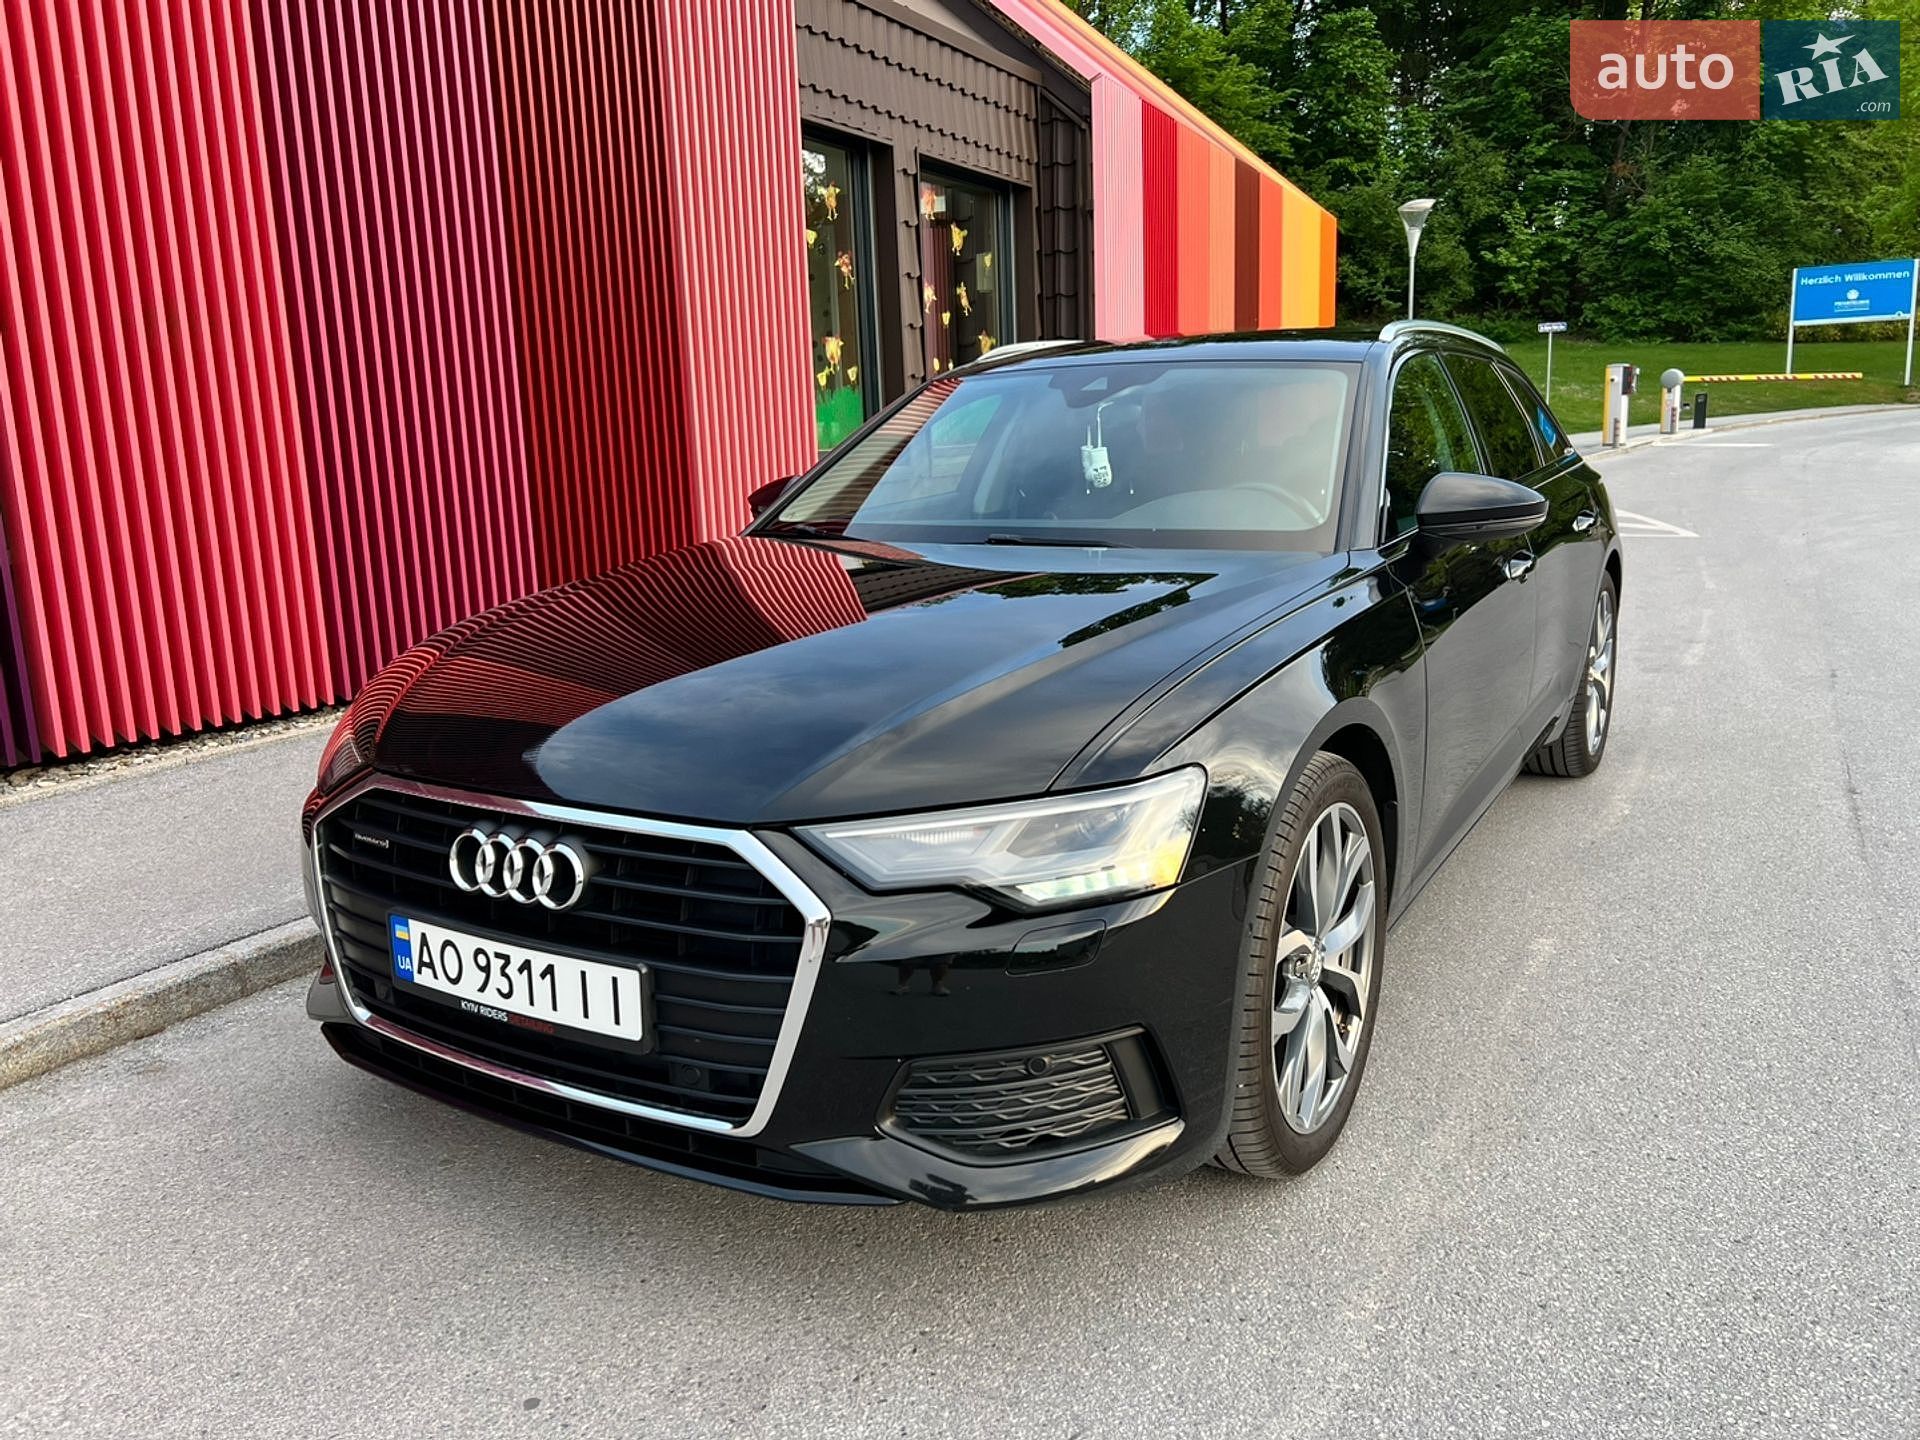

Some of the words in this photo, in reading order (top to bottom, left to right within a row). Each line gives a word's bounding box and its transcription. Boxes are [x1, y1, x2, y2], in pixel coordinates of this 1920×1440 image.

[1800, 274, 1841, 286] Herzlich
[1844, 270, 1910, 282] Willkommen
[397, 954, 413, 972] UA
[416, 931, 464, 986] AO
[472, 947, 558, 1012] 9311
[479, 1005, 509, 1022] RIDERS
